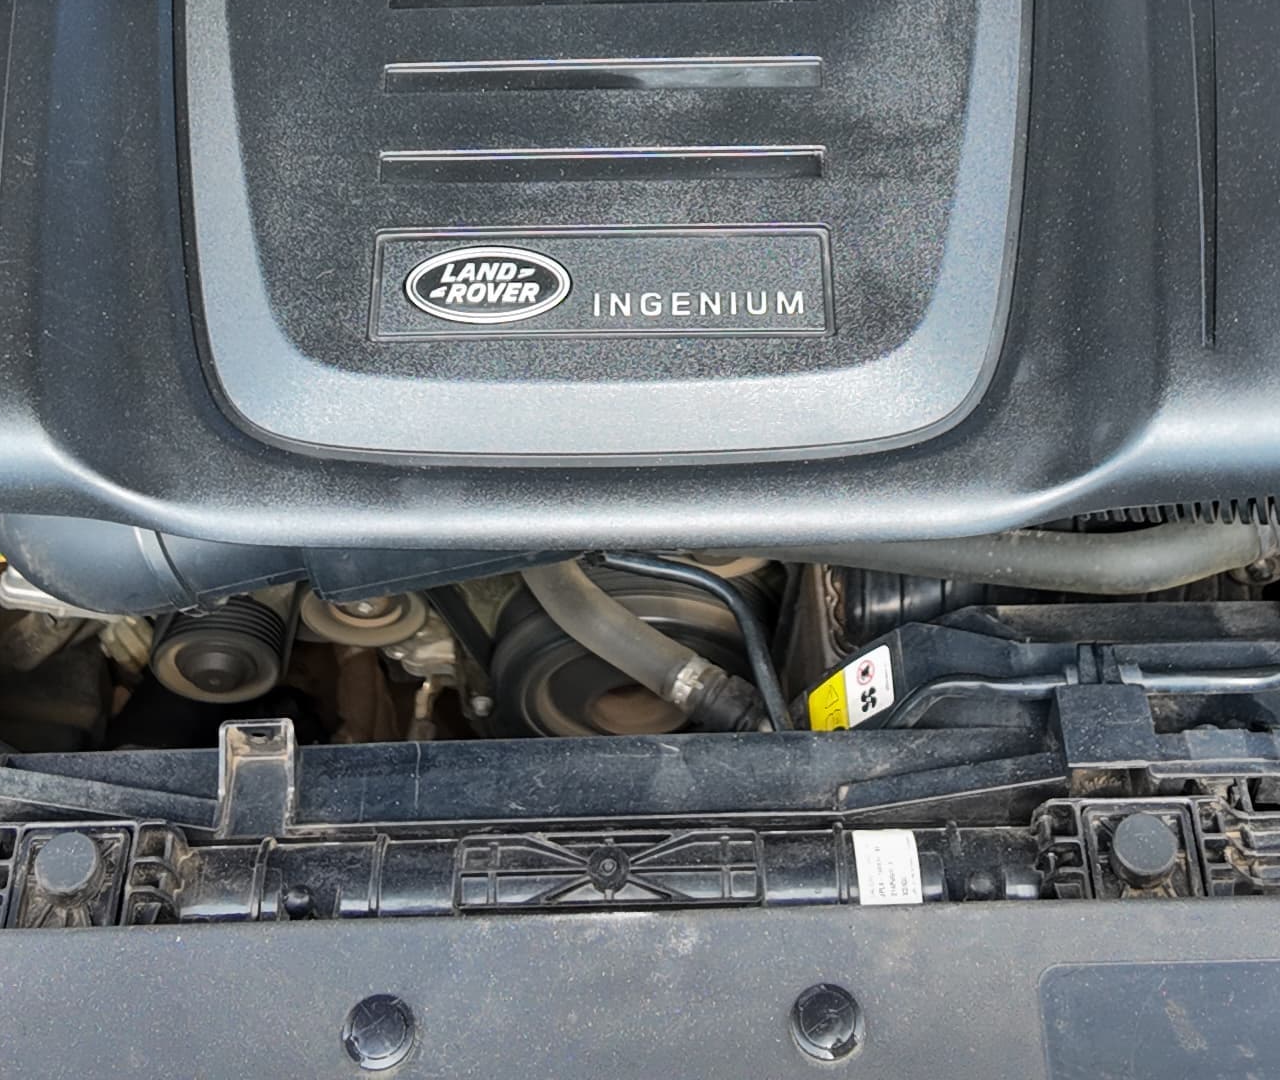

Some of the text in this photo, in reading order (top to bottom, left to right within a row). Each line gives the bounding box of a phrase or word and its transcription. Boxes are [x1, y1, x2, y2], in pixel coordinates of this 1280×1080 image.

[440, 262, 518, 283] LAND
[445, 282, 540, 304] ROVER
[593, 290, 805, 317] INGENIUM
